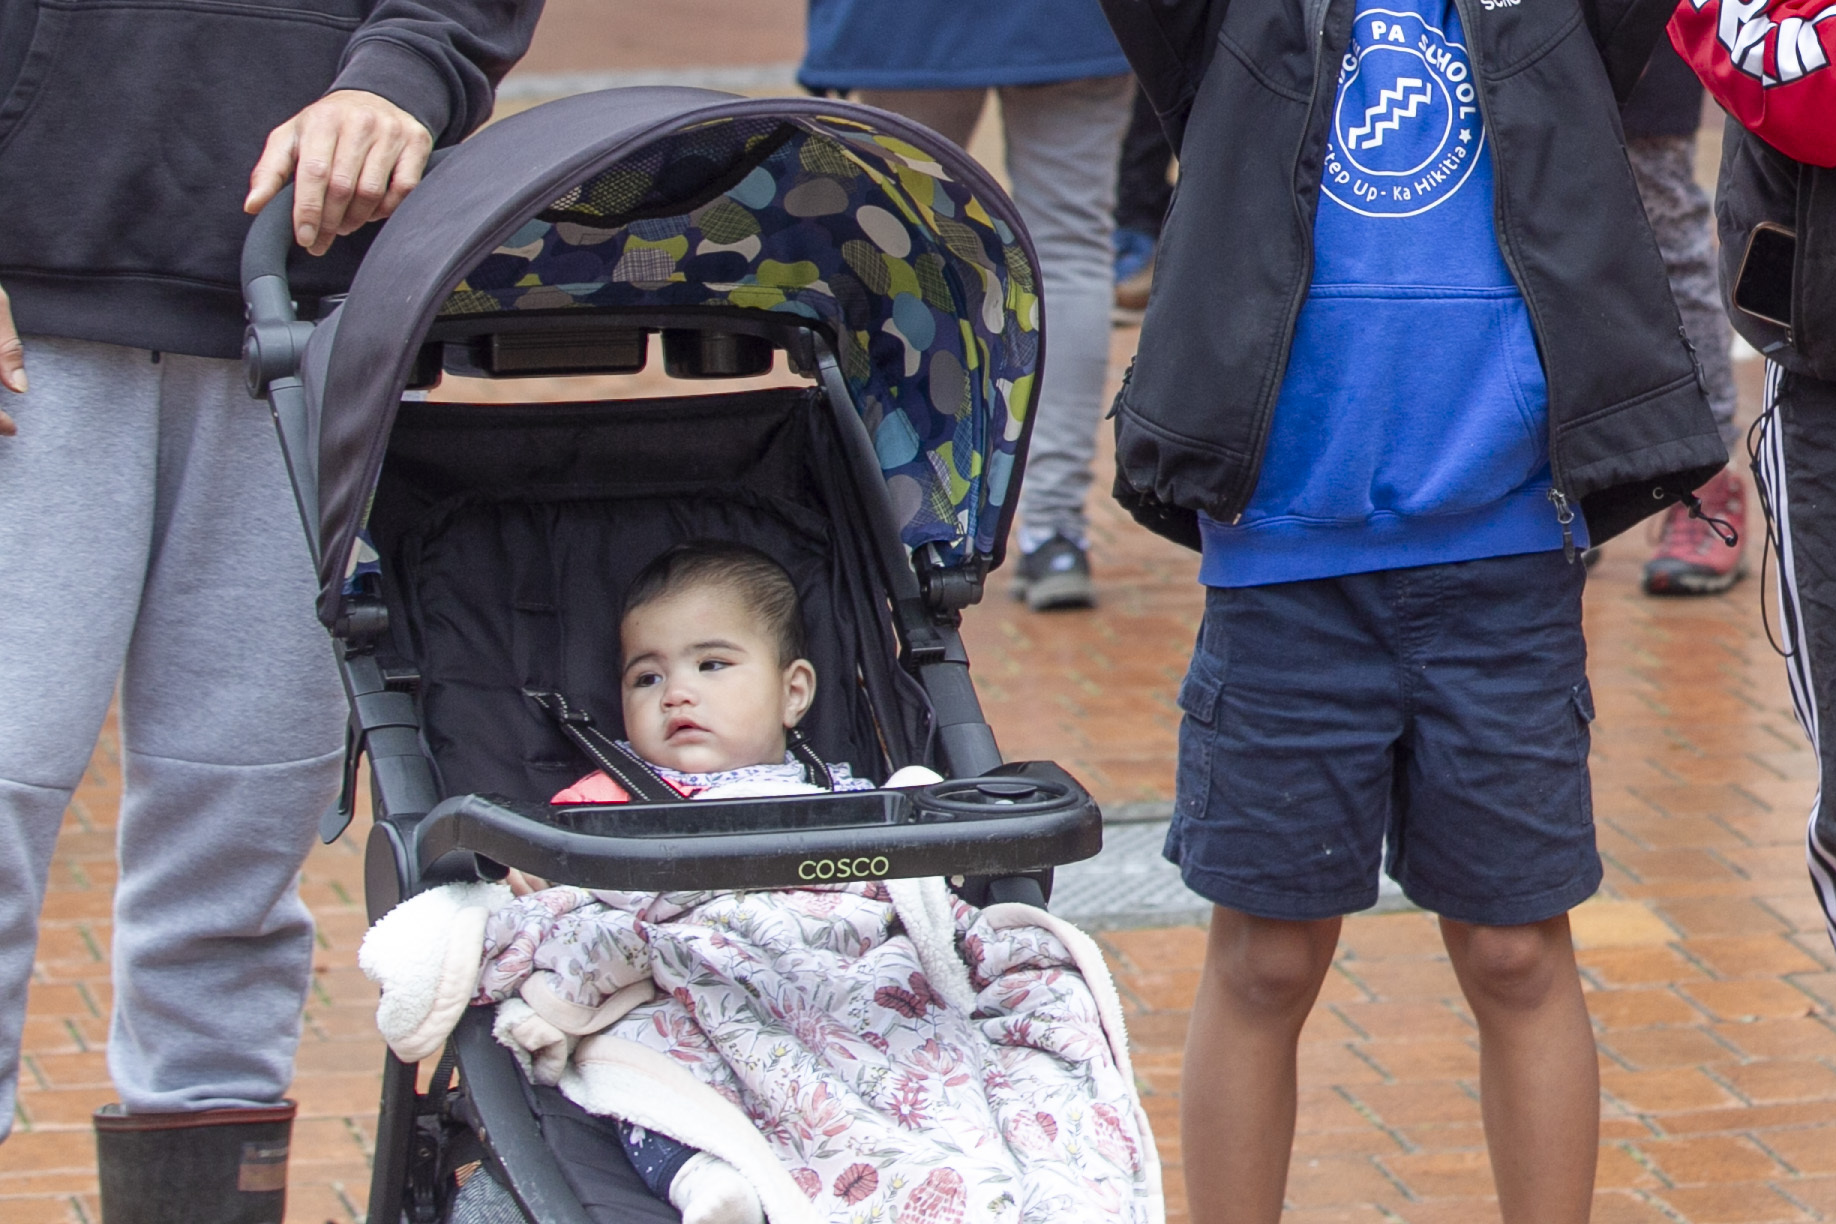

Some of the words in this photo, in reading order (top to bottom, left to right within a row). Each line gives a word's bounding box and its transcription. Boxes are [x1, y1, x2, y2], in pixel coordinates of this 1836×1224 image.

[1371, 20, 1406, 43] PA
[1418, 33, 1476, 120] SCHOOL
[1392, 185, 1412, 201] Ka
[1413, 145, 1467, 196] Hikitia
[798, 855, 890, 880] COSCO
